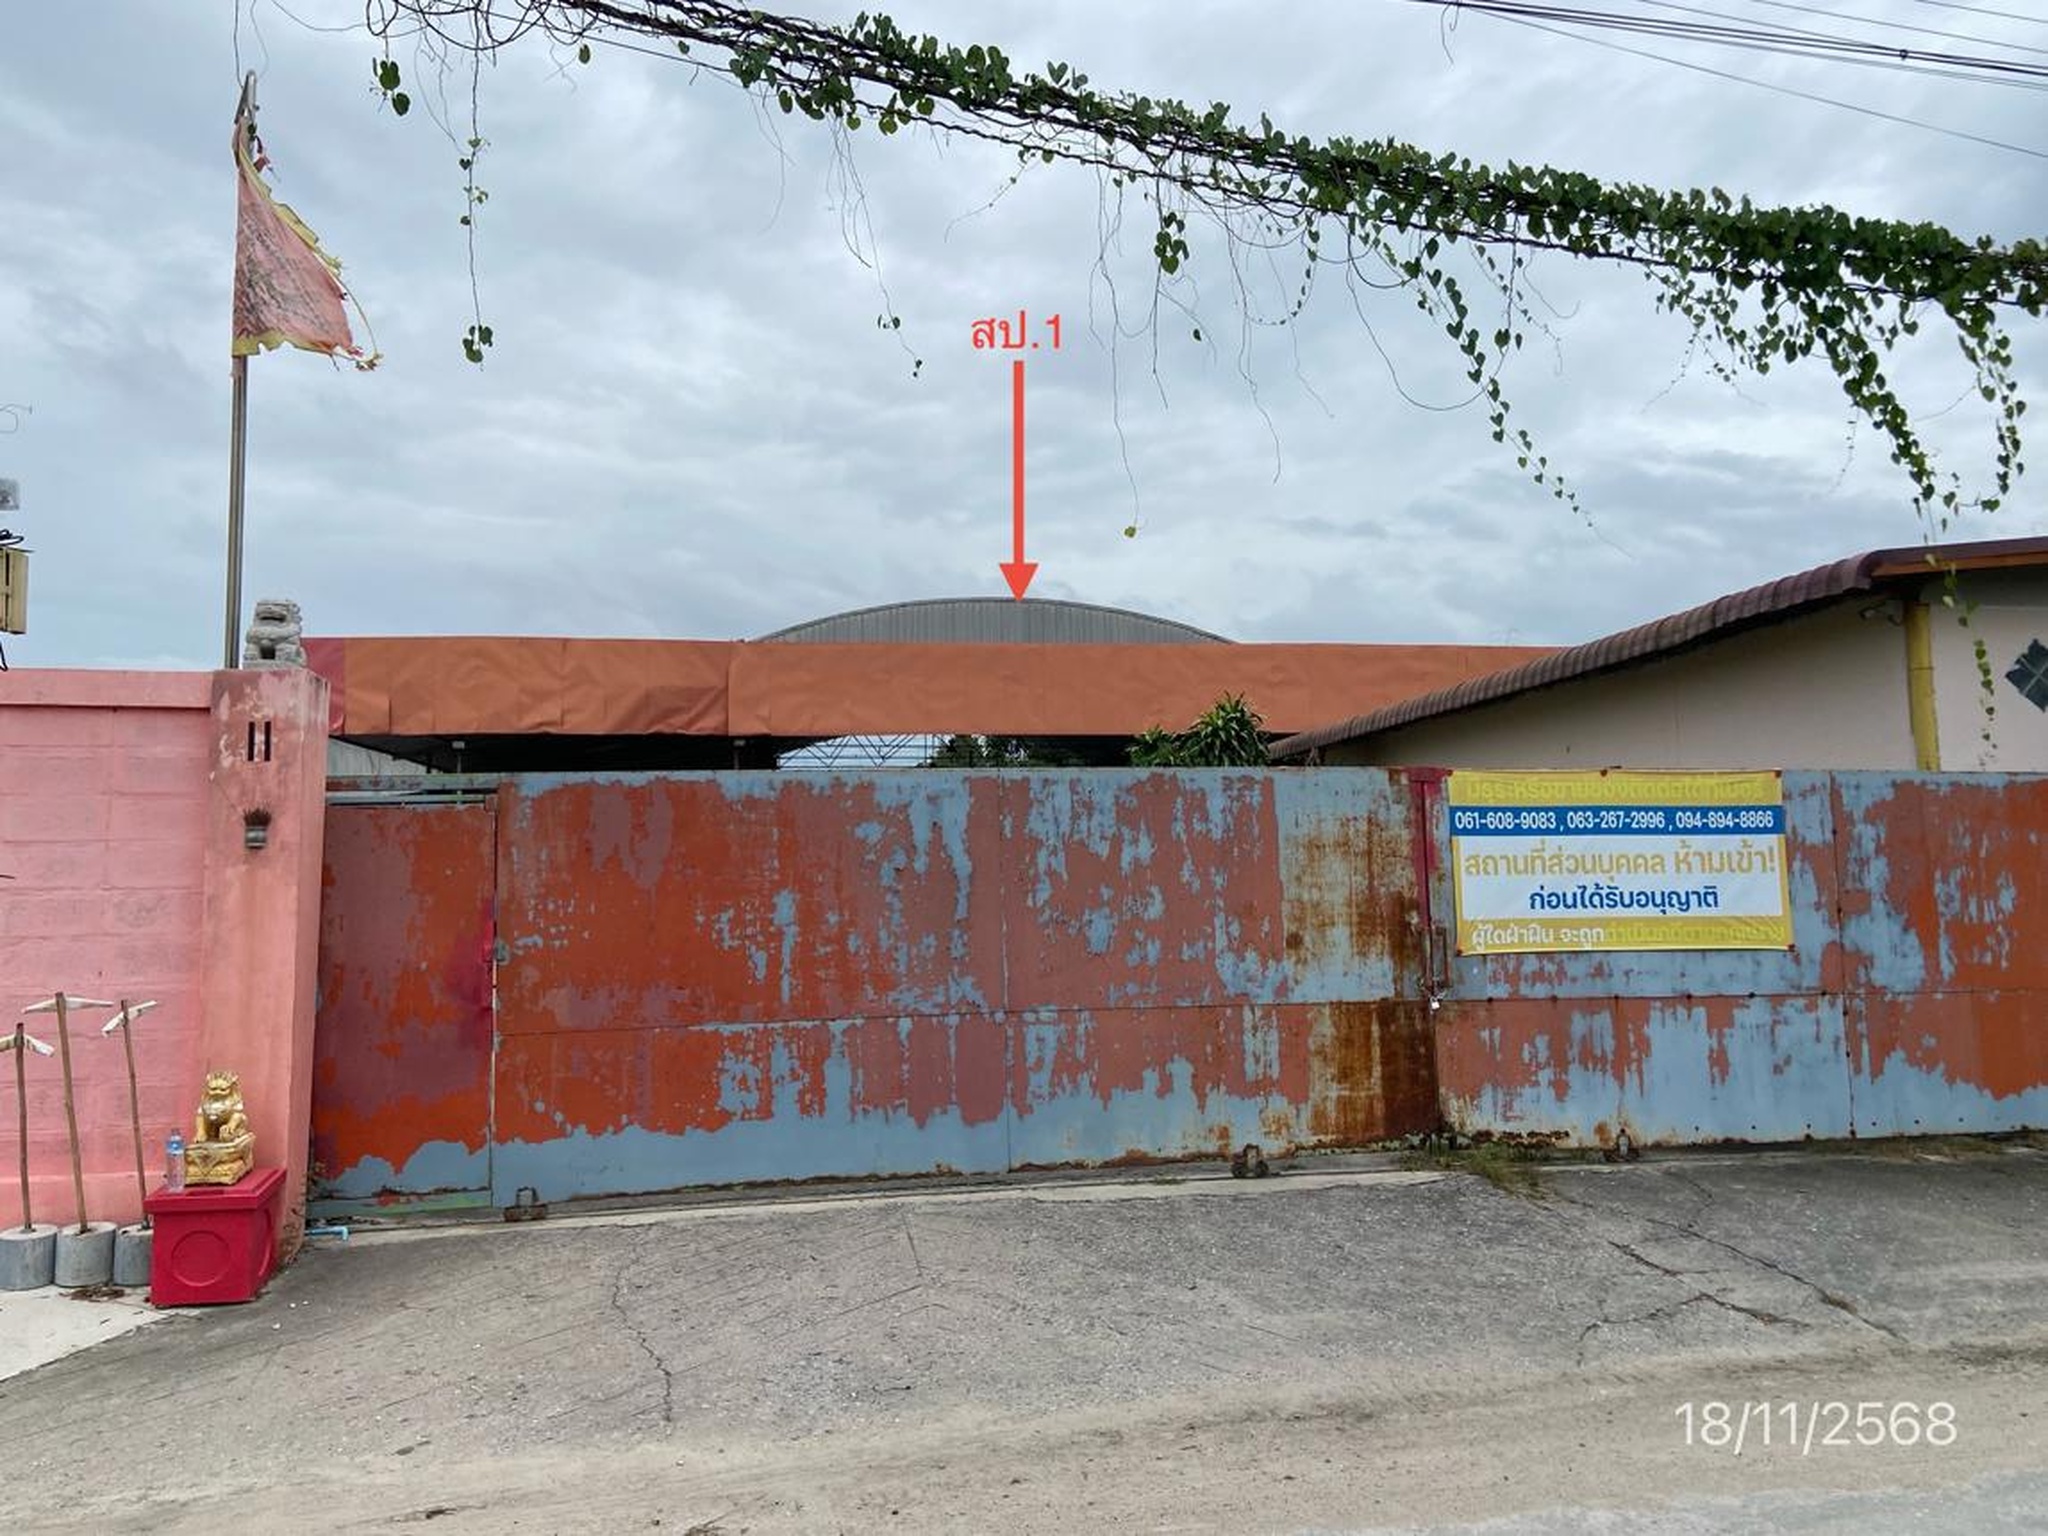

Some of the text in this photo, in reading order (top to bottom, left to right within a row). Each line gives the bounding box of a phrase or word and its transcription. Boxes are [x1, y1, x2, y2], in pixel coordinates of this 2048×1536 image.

[1455, 811, 1557, 829] 061-608-9083
[1567, 811, 1665, 829] 063-267-2996
[1464, 838, 1775, 882] สถานที่ส่วนบุคคล ห้ามเข้า!
[1529, 883, 1719, 915] ก่อนได้รับอนุญาติ
[1472, 922, 1554, 950] ผู้ใดฝ่าฝืน
